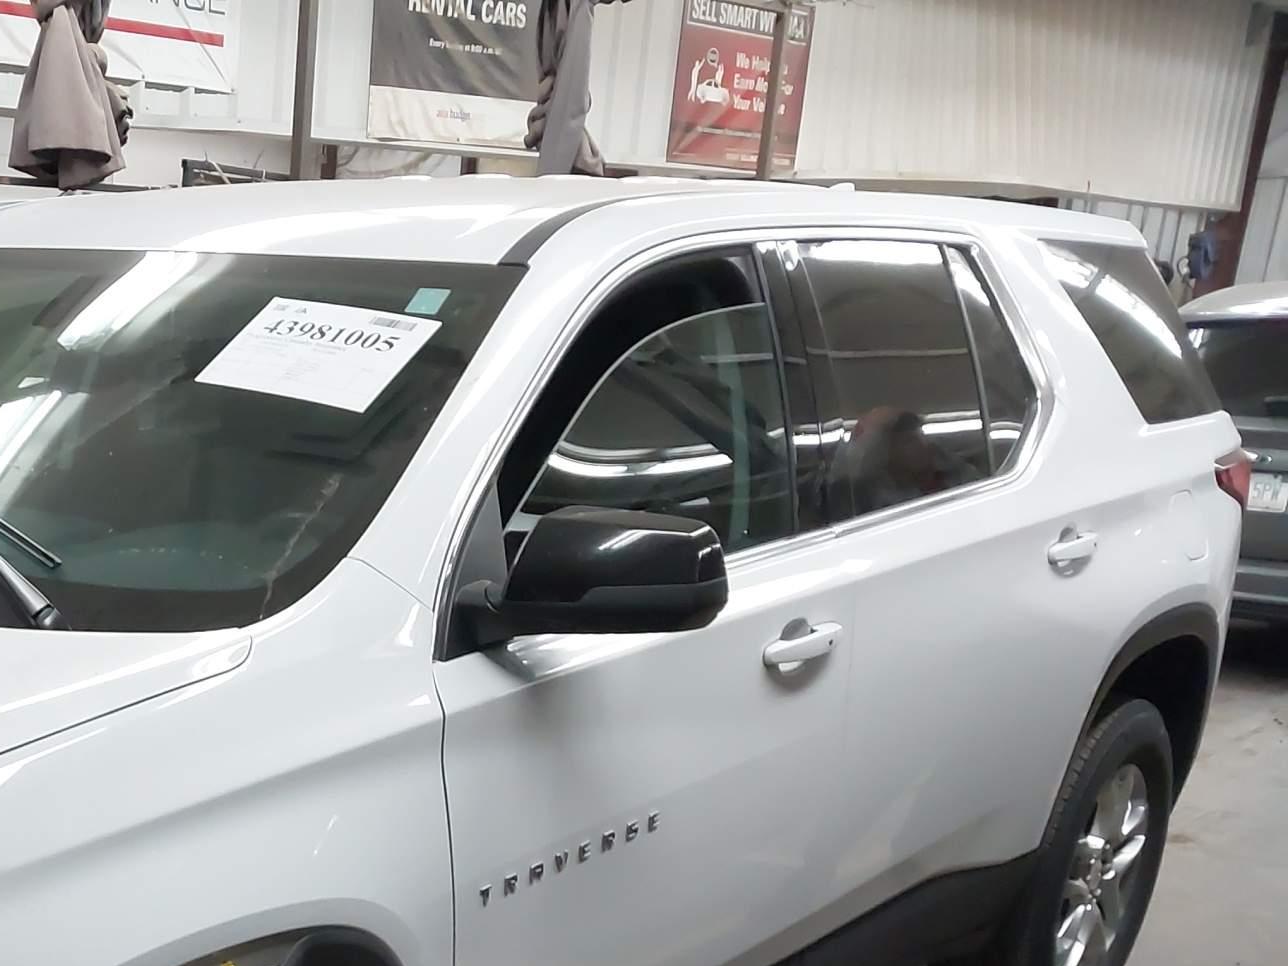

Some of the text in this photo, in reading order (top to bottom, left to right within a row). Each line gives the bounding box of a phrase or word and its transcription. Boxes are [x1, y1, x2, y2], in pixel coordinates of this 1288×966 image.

[481, 0, 527, 28] CARS
[692, 0, 716, 22] SELL
[719, 3, 759, 30] SMART
[736, 52, 750, 69] We
[264, 319, 401, 352] 43981005
[479, 810, 660, 907] TRAVERSE
